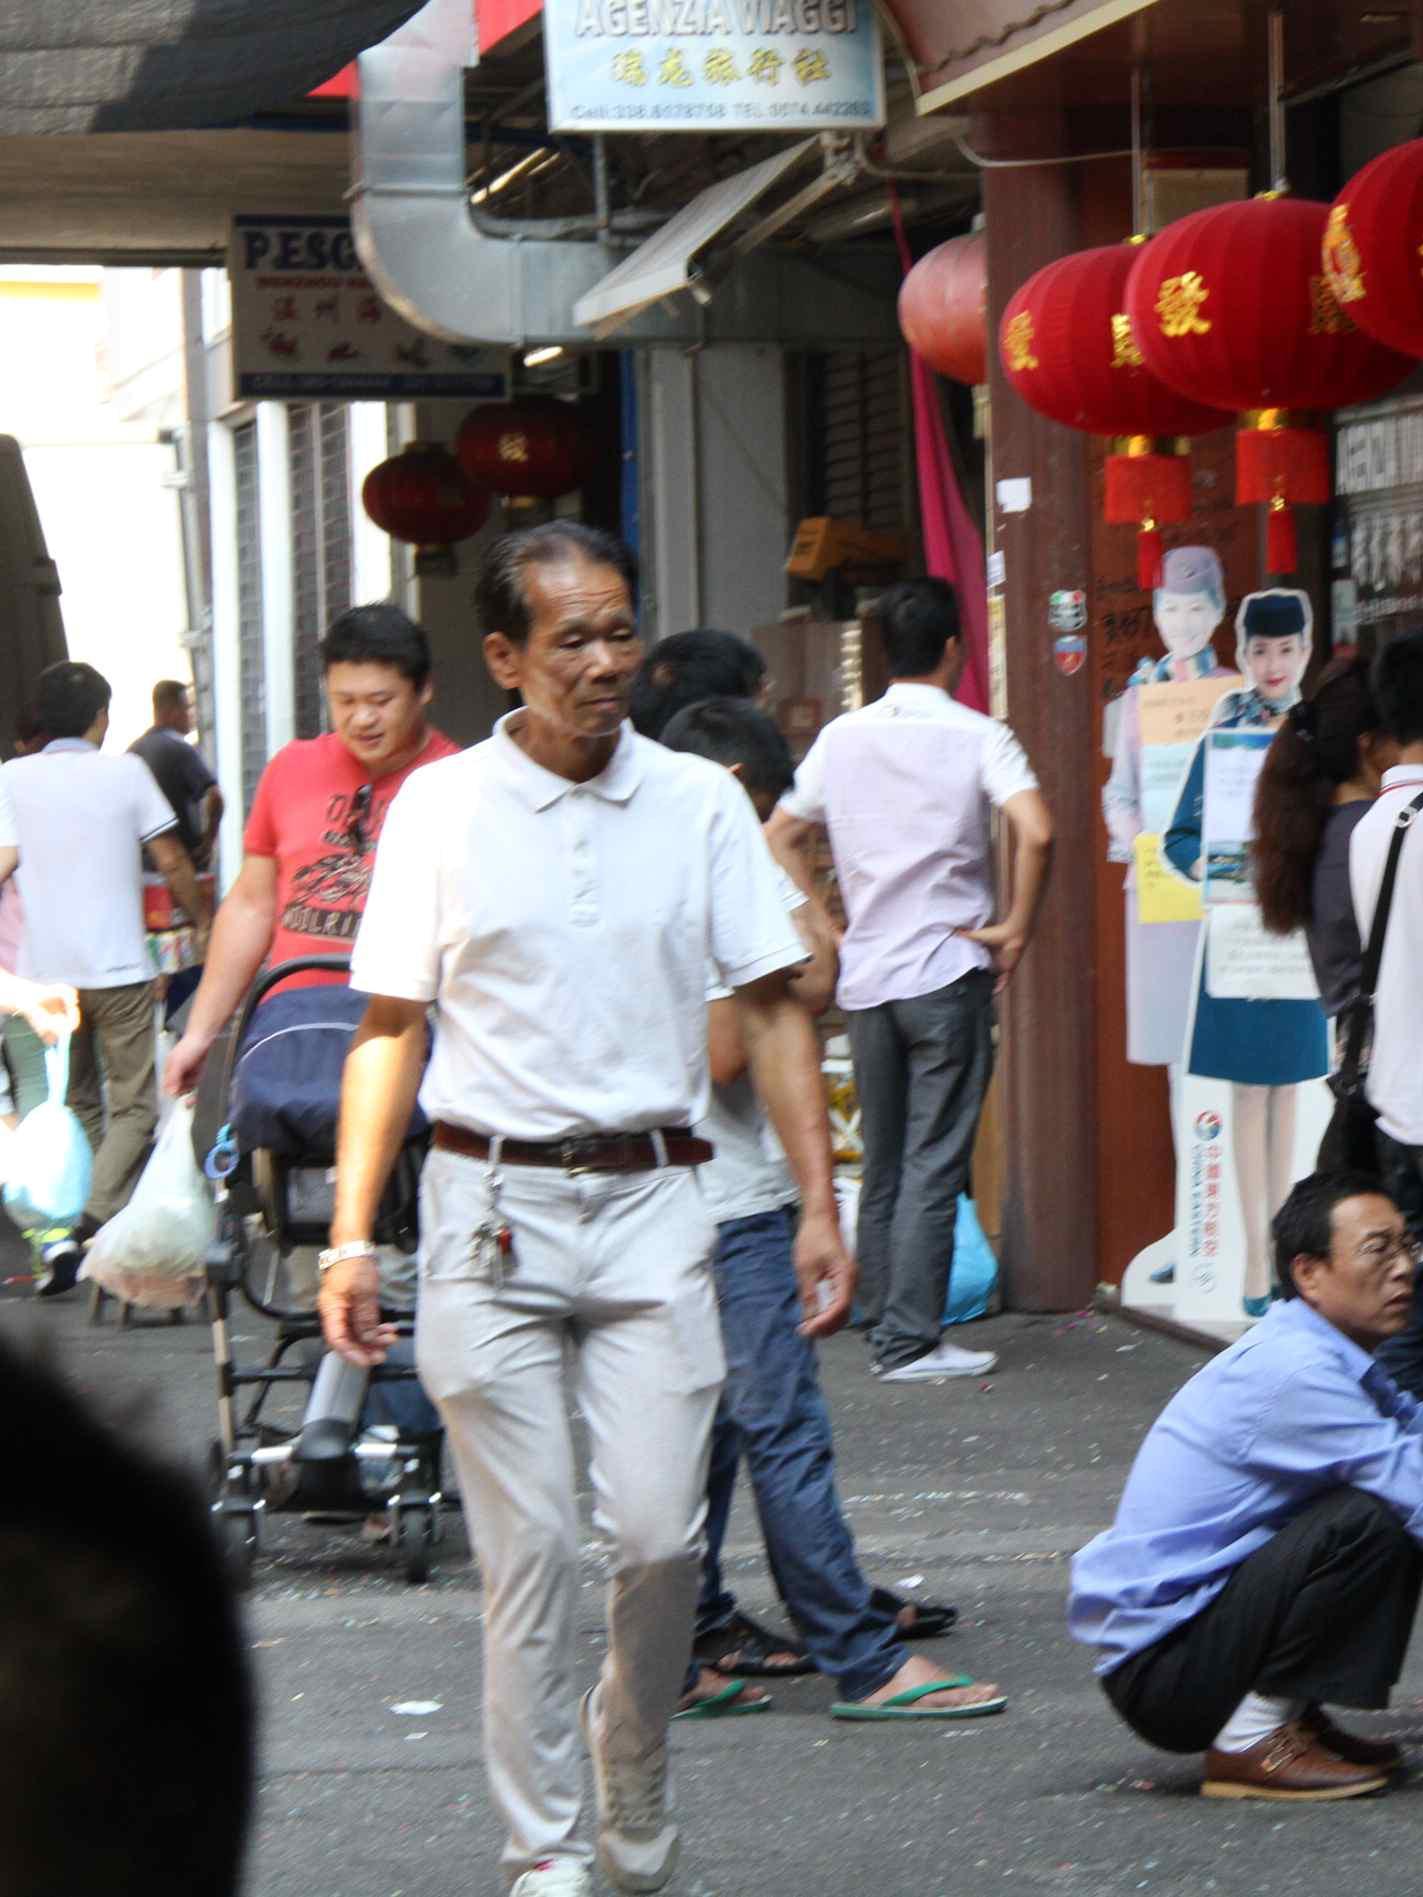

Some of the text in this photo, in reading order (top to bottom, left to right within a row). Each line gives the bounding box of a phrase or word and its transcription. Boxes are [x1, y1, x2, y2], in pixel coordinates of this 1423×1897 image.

[576, 0, 857, 36] AGENZIA VIAGGI
[243, 231, 365, 271] PESC
